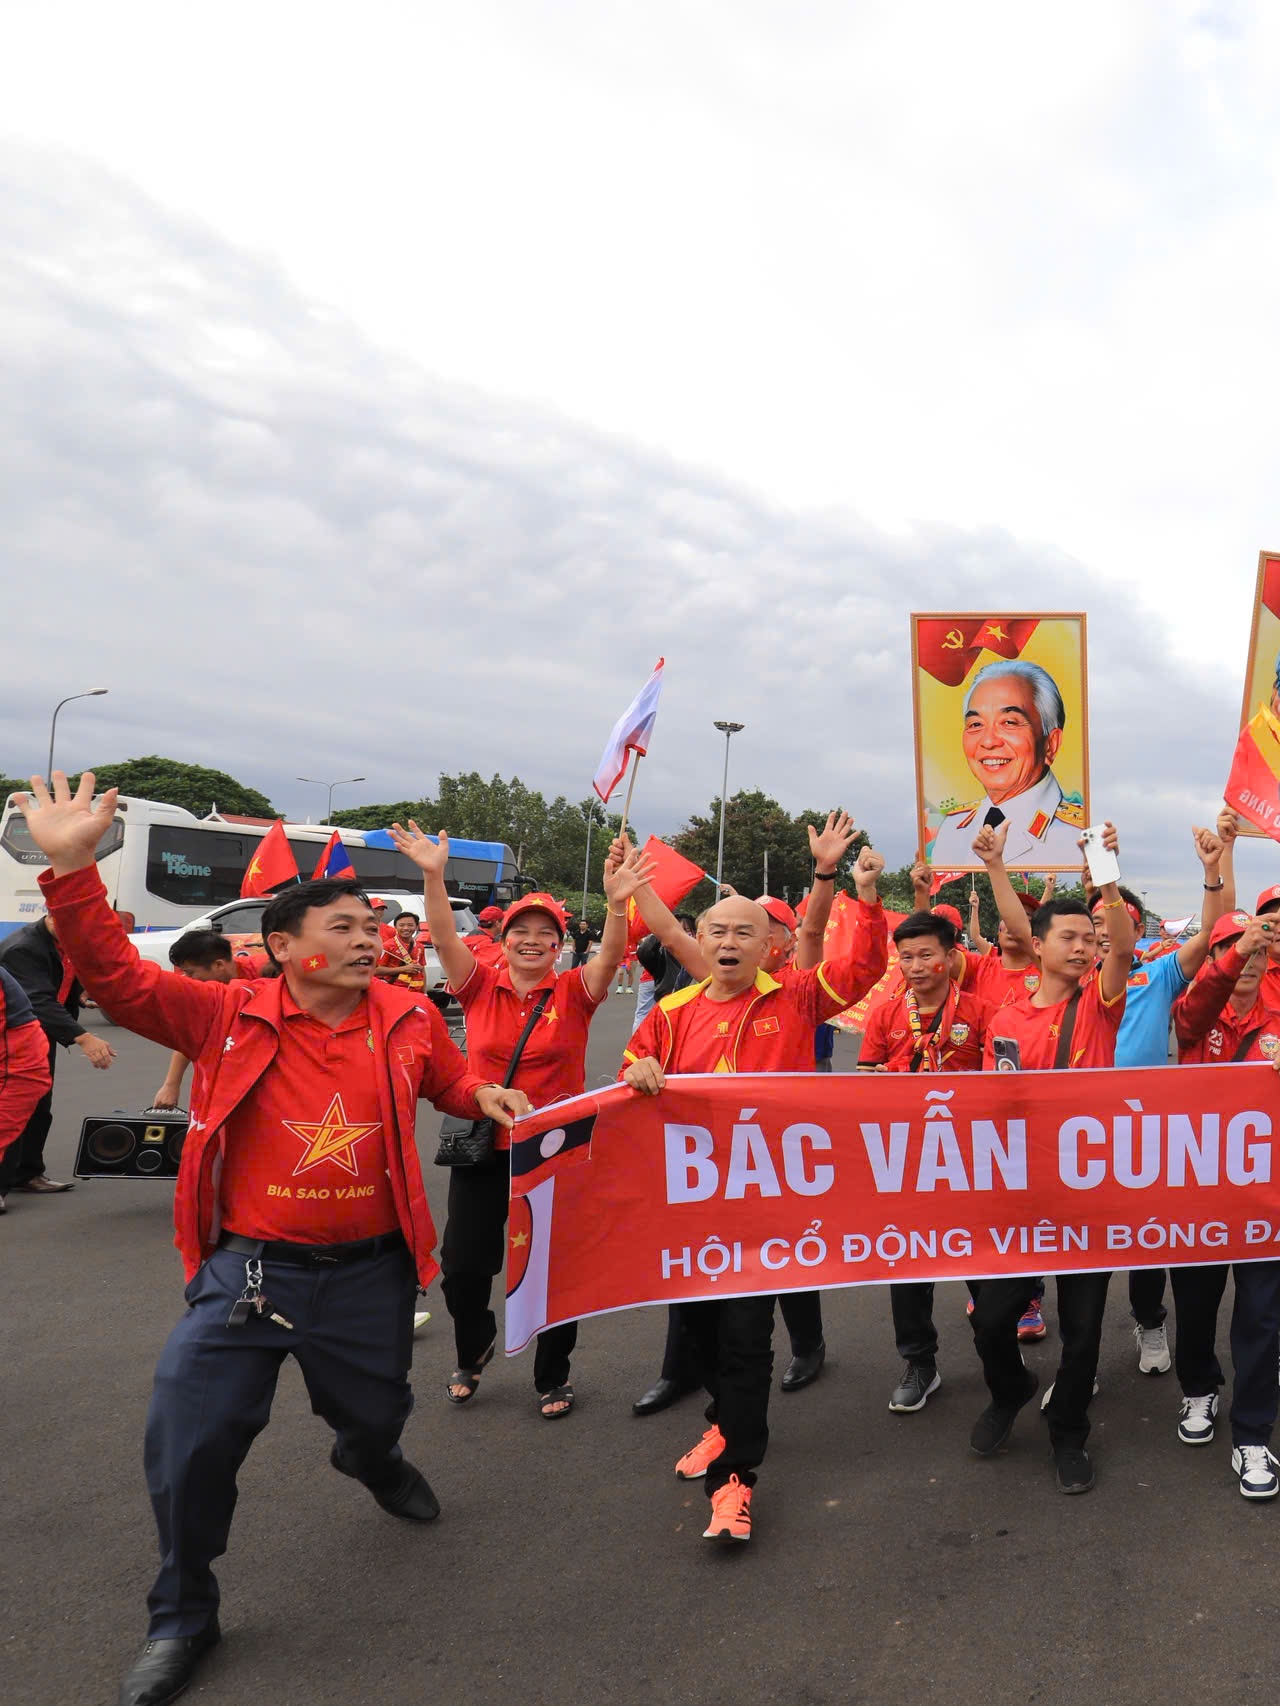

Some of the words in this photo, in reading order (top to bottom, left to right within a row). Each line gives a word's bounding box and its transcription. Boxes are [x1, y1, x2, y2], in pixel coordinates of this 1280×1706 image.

[167, 861, 212, 877] Home
[1208, 1029, 1223, 1046] 23
[664, 1107, 835, 1204] BÁC
[860, 1089, 1028, 1193] VẪN
[1058, 1099, 1272, 1190] CÙNG
[267, 1184, 292, 1198] BIA
[296, 1188, 330, 1199] SAO
[335, 1185, 375, 1199] VÀNG
[662, 1235, 742, 1282] HỘI
[759, 1219, 827, 1269] CỔ
[841, 1224, 972, 1267] ĐỘNG
[989, 1219, 1089, 1254] VIÊN
[1107, 1217, 1228, 1250] BÓNG
